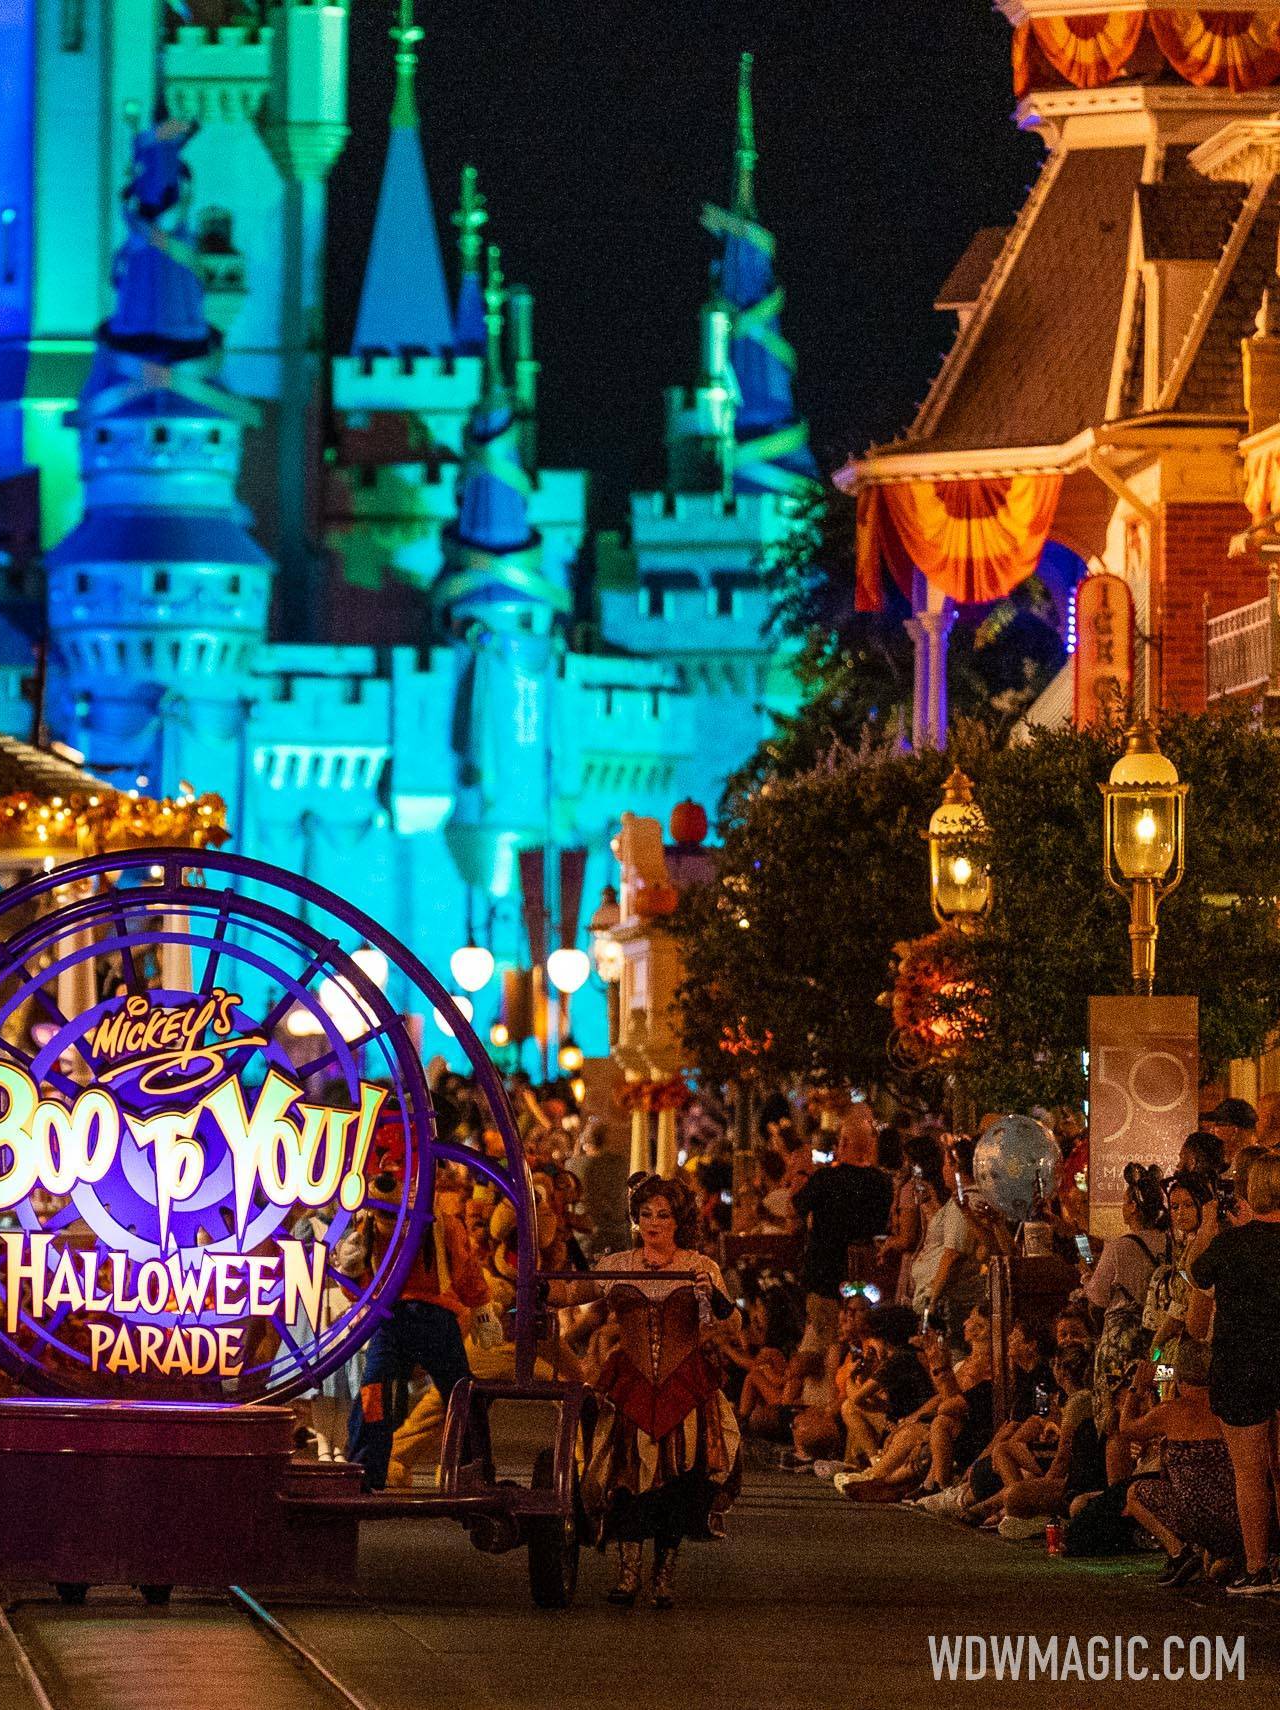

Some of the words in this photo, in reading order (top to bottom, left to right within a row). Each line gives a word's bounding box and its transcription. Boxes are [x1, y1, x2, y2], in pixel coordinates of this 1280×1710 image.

[1100, 1046, 1189, 1142] 50
[124, 1110, 207, 1251] TO
[201, 1069, 389, 1248] YOU!
[88, 1323, 245, 1377] PARADE
